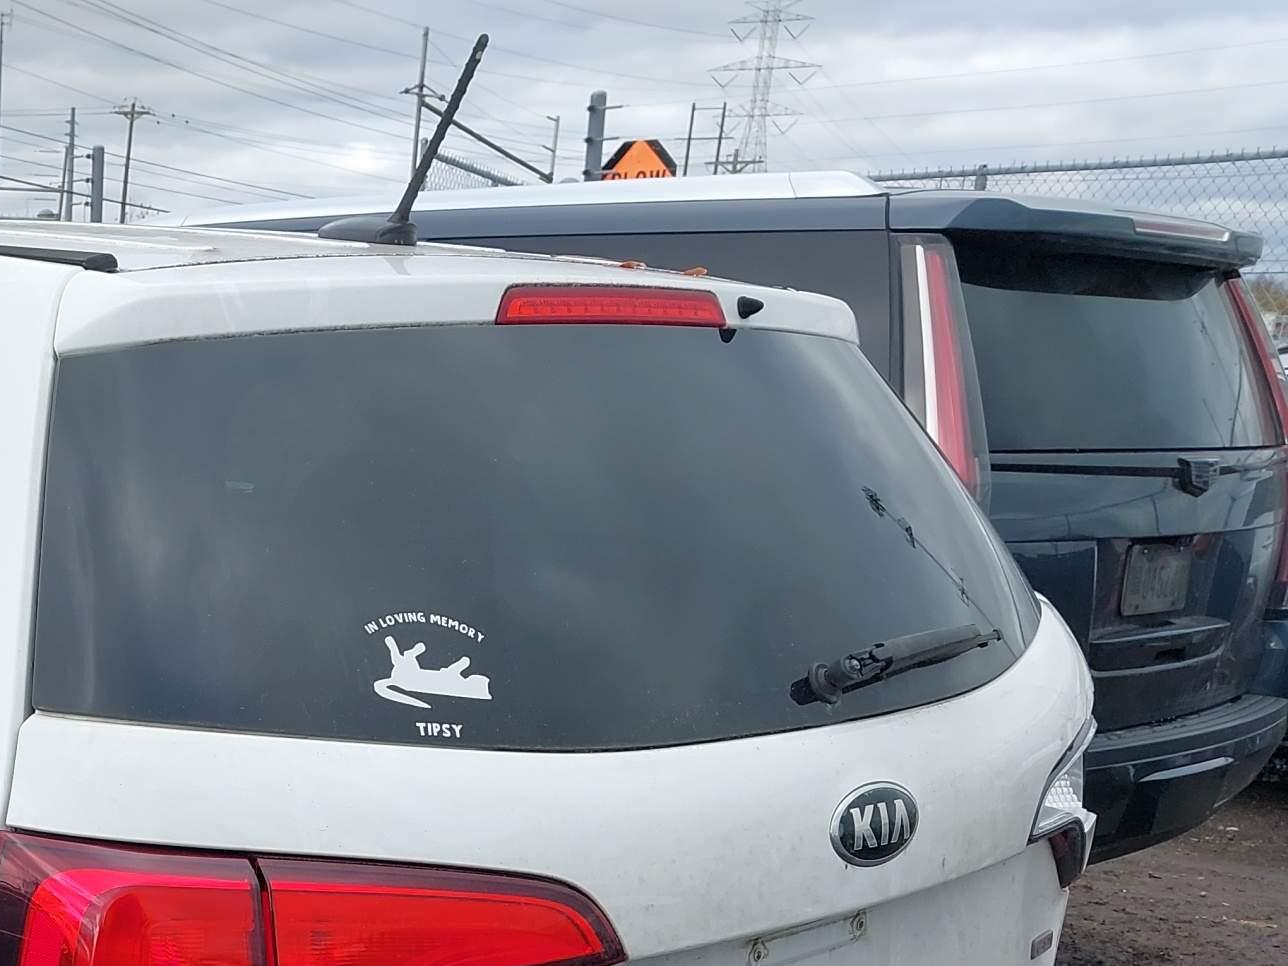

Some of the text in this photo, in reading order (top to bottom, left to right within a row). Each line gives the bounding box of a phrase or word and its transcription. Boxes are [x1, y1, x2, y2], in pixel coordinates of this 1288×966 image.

[364, 611, 485, 643] IN LOVING MEMORY
[415, 722, 463, 738] TIPSY
[849, 798, 911, 851] KIA
